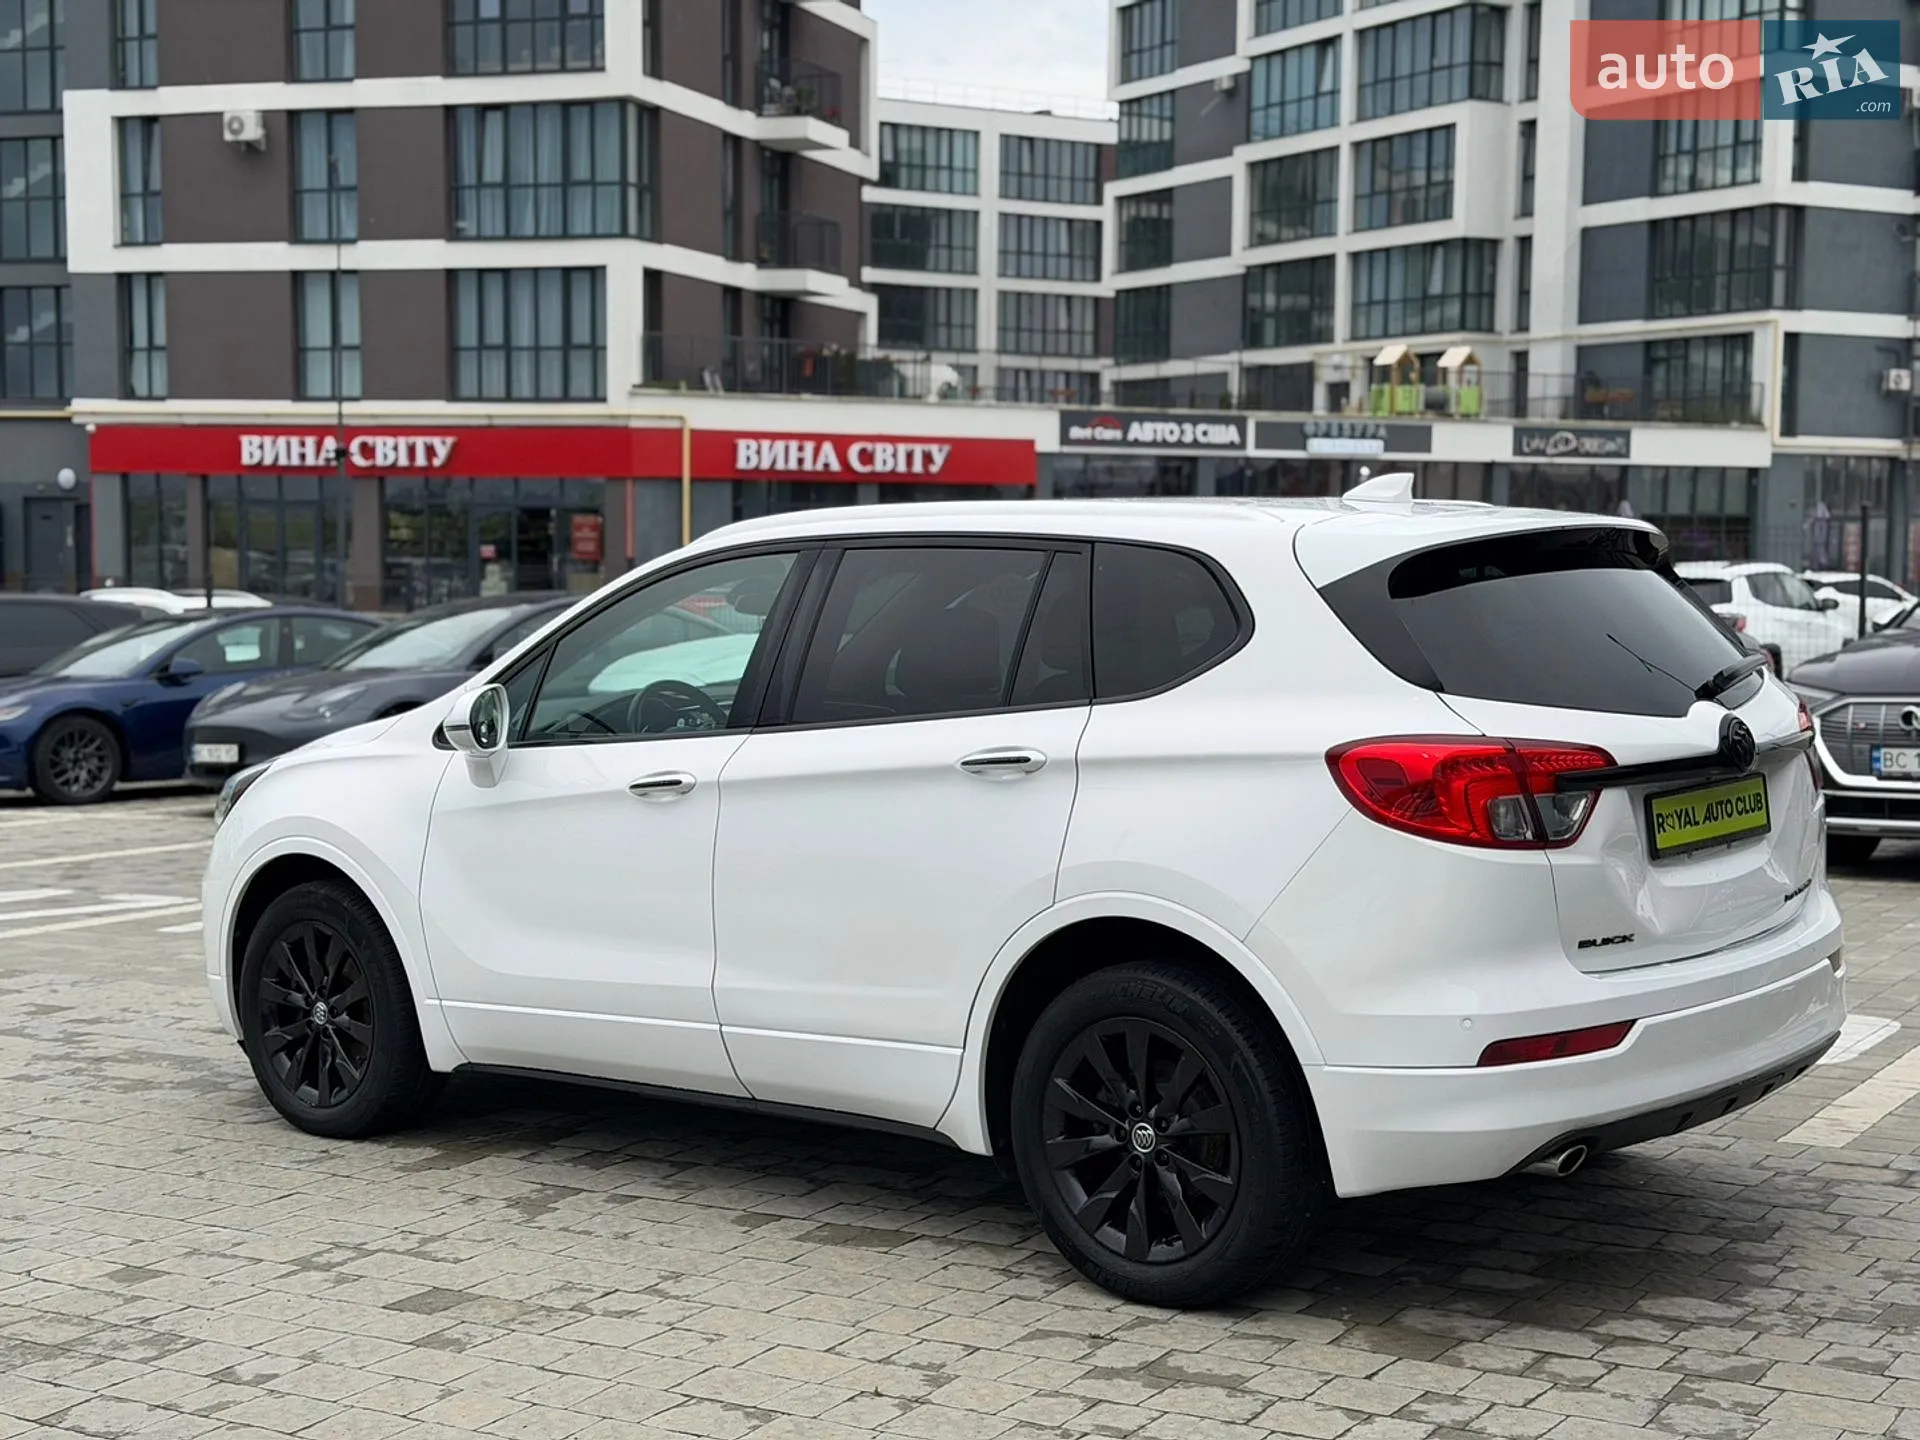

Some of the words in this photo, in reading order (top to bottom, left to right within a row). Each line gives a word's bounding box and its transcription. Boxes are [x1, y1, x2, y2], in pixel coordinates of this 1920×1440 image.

[1126, 421, 1181, 443] АВТО
[240, 435, 338, 467] ВИНА
[349, 435, 457, 468] СВІТУ
[735, 439, 842, 472] ВИНА
[847, 441, 952, 474] СВІТУ
[1883, 752, 1907, 768] BC
[1702, 798, 1734, 825] AUTO
[1735, 792, 1763, 816] CLUB
[1578, 933, 1635, 949] BUICK
